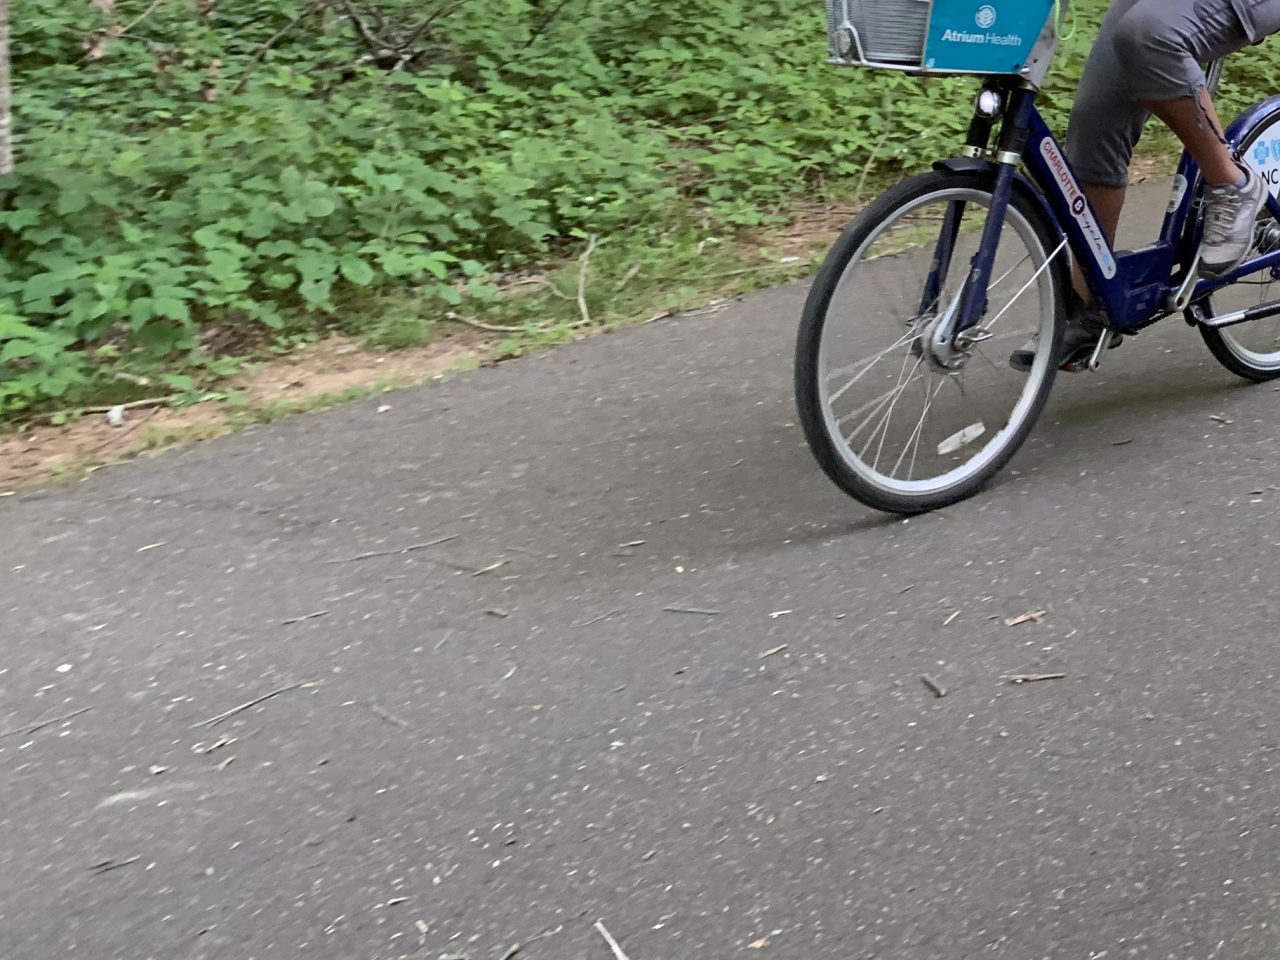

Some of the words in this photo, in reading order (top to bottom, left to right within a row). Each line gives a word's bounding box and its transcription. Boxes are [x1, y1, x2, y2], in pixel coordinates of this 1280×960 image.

[941, 29, 984, 43] Atrium
[985, 32, 1022, 46] Health
[1044, 141, 1077, 199] CHARLOTTE
[1262, 168, 1279, 185] NC
